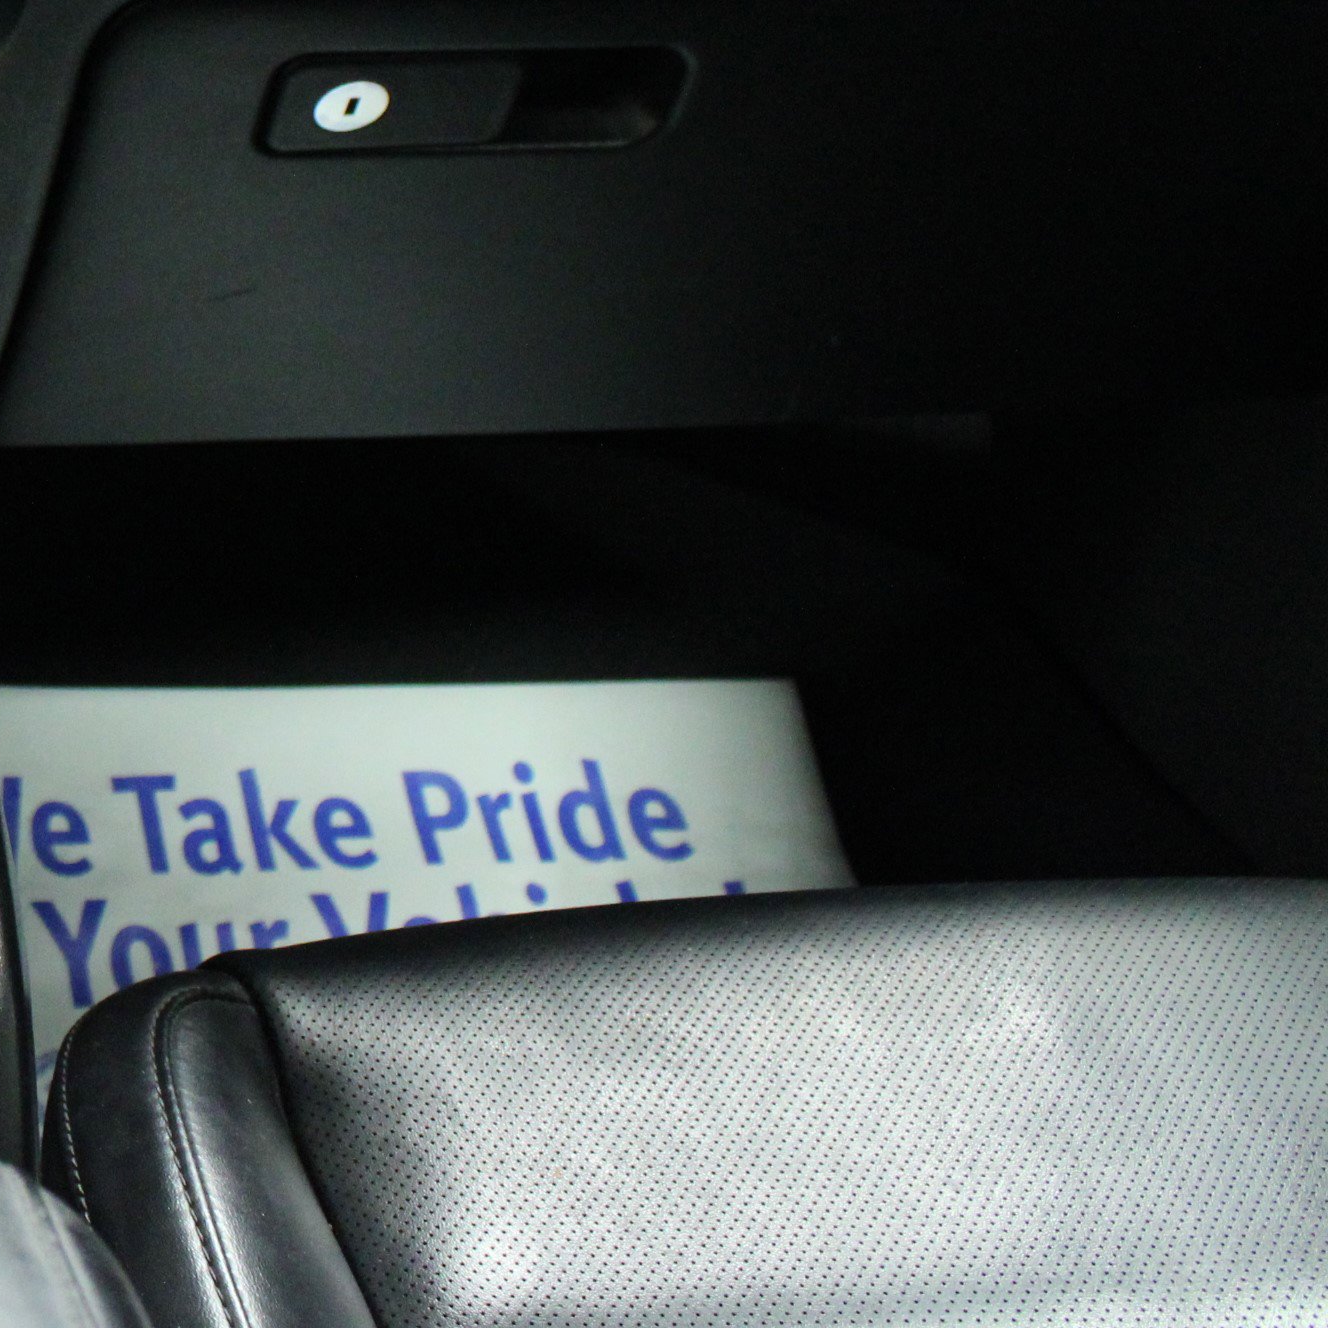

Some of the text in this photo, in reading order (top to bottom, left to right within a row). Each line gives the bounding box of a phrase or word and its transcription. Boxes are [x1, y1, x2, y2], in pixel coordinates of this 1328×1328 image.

[2, 758, 697, 878] e Take Pride
